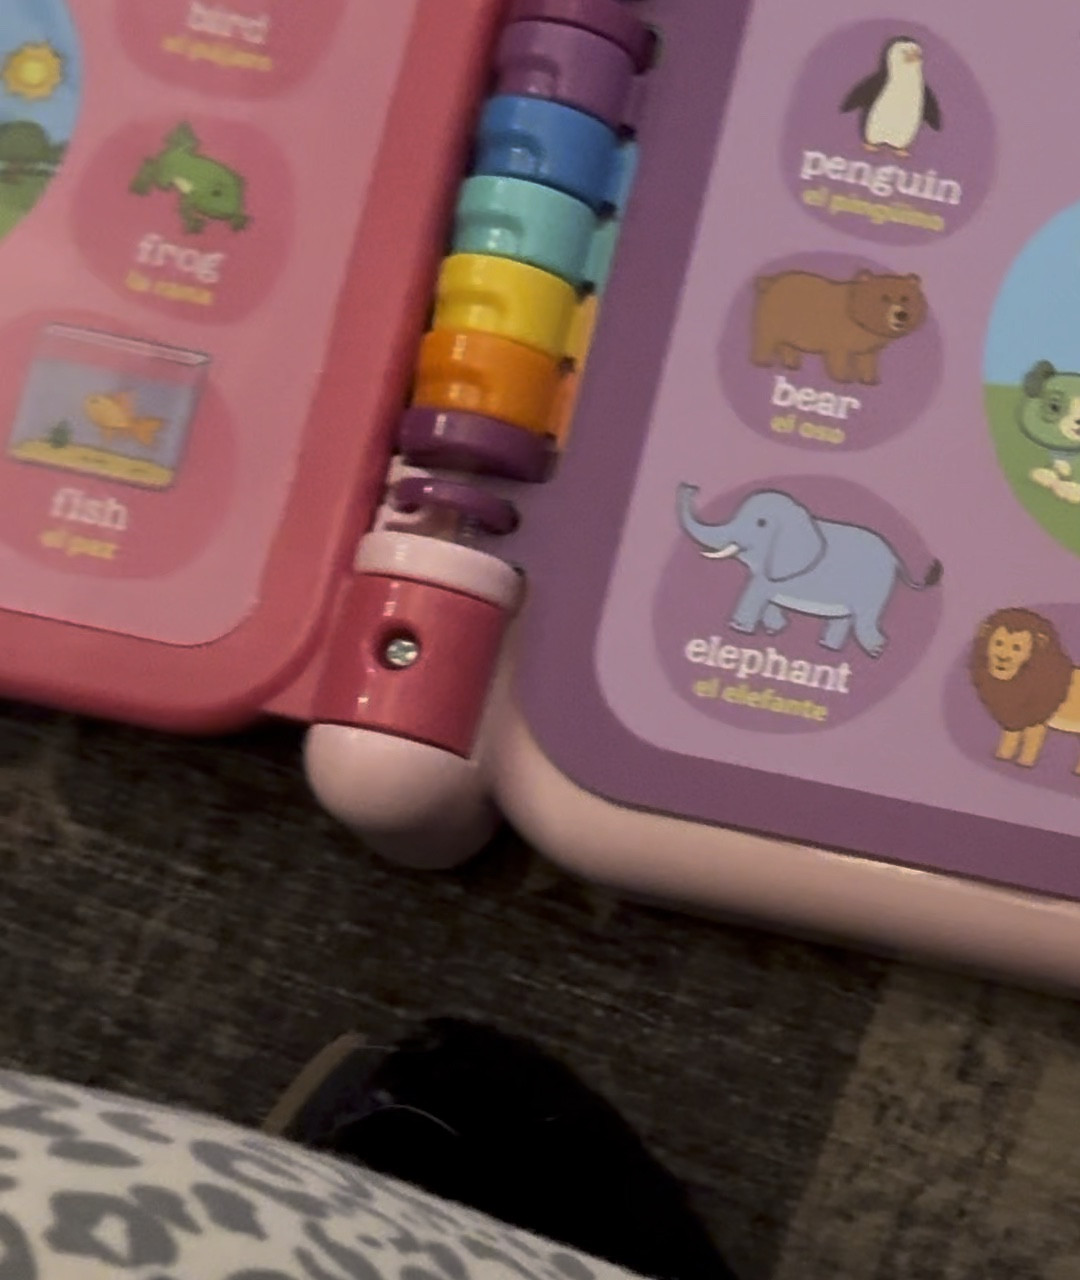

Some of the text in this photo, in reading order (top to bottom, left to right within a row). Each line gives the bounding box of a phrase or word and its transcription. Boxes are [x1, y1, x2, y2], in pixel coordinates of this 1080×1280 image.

[800, 150, 962, 205] penguin
[136, 233, 227, 283] frog
[772, 376, 861, 419] bear
[50, 488, 128, 531] fish
[685, 636, 852, 694] elephant
[693, 677, 828, 722] el elefante
